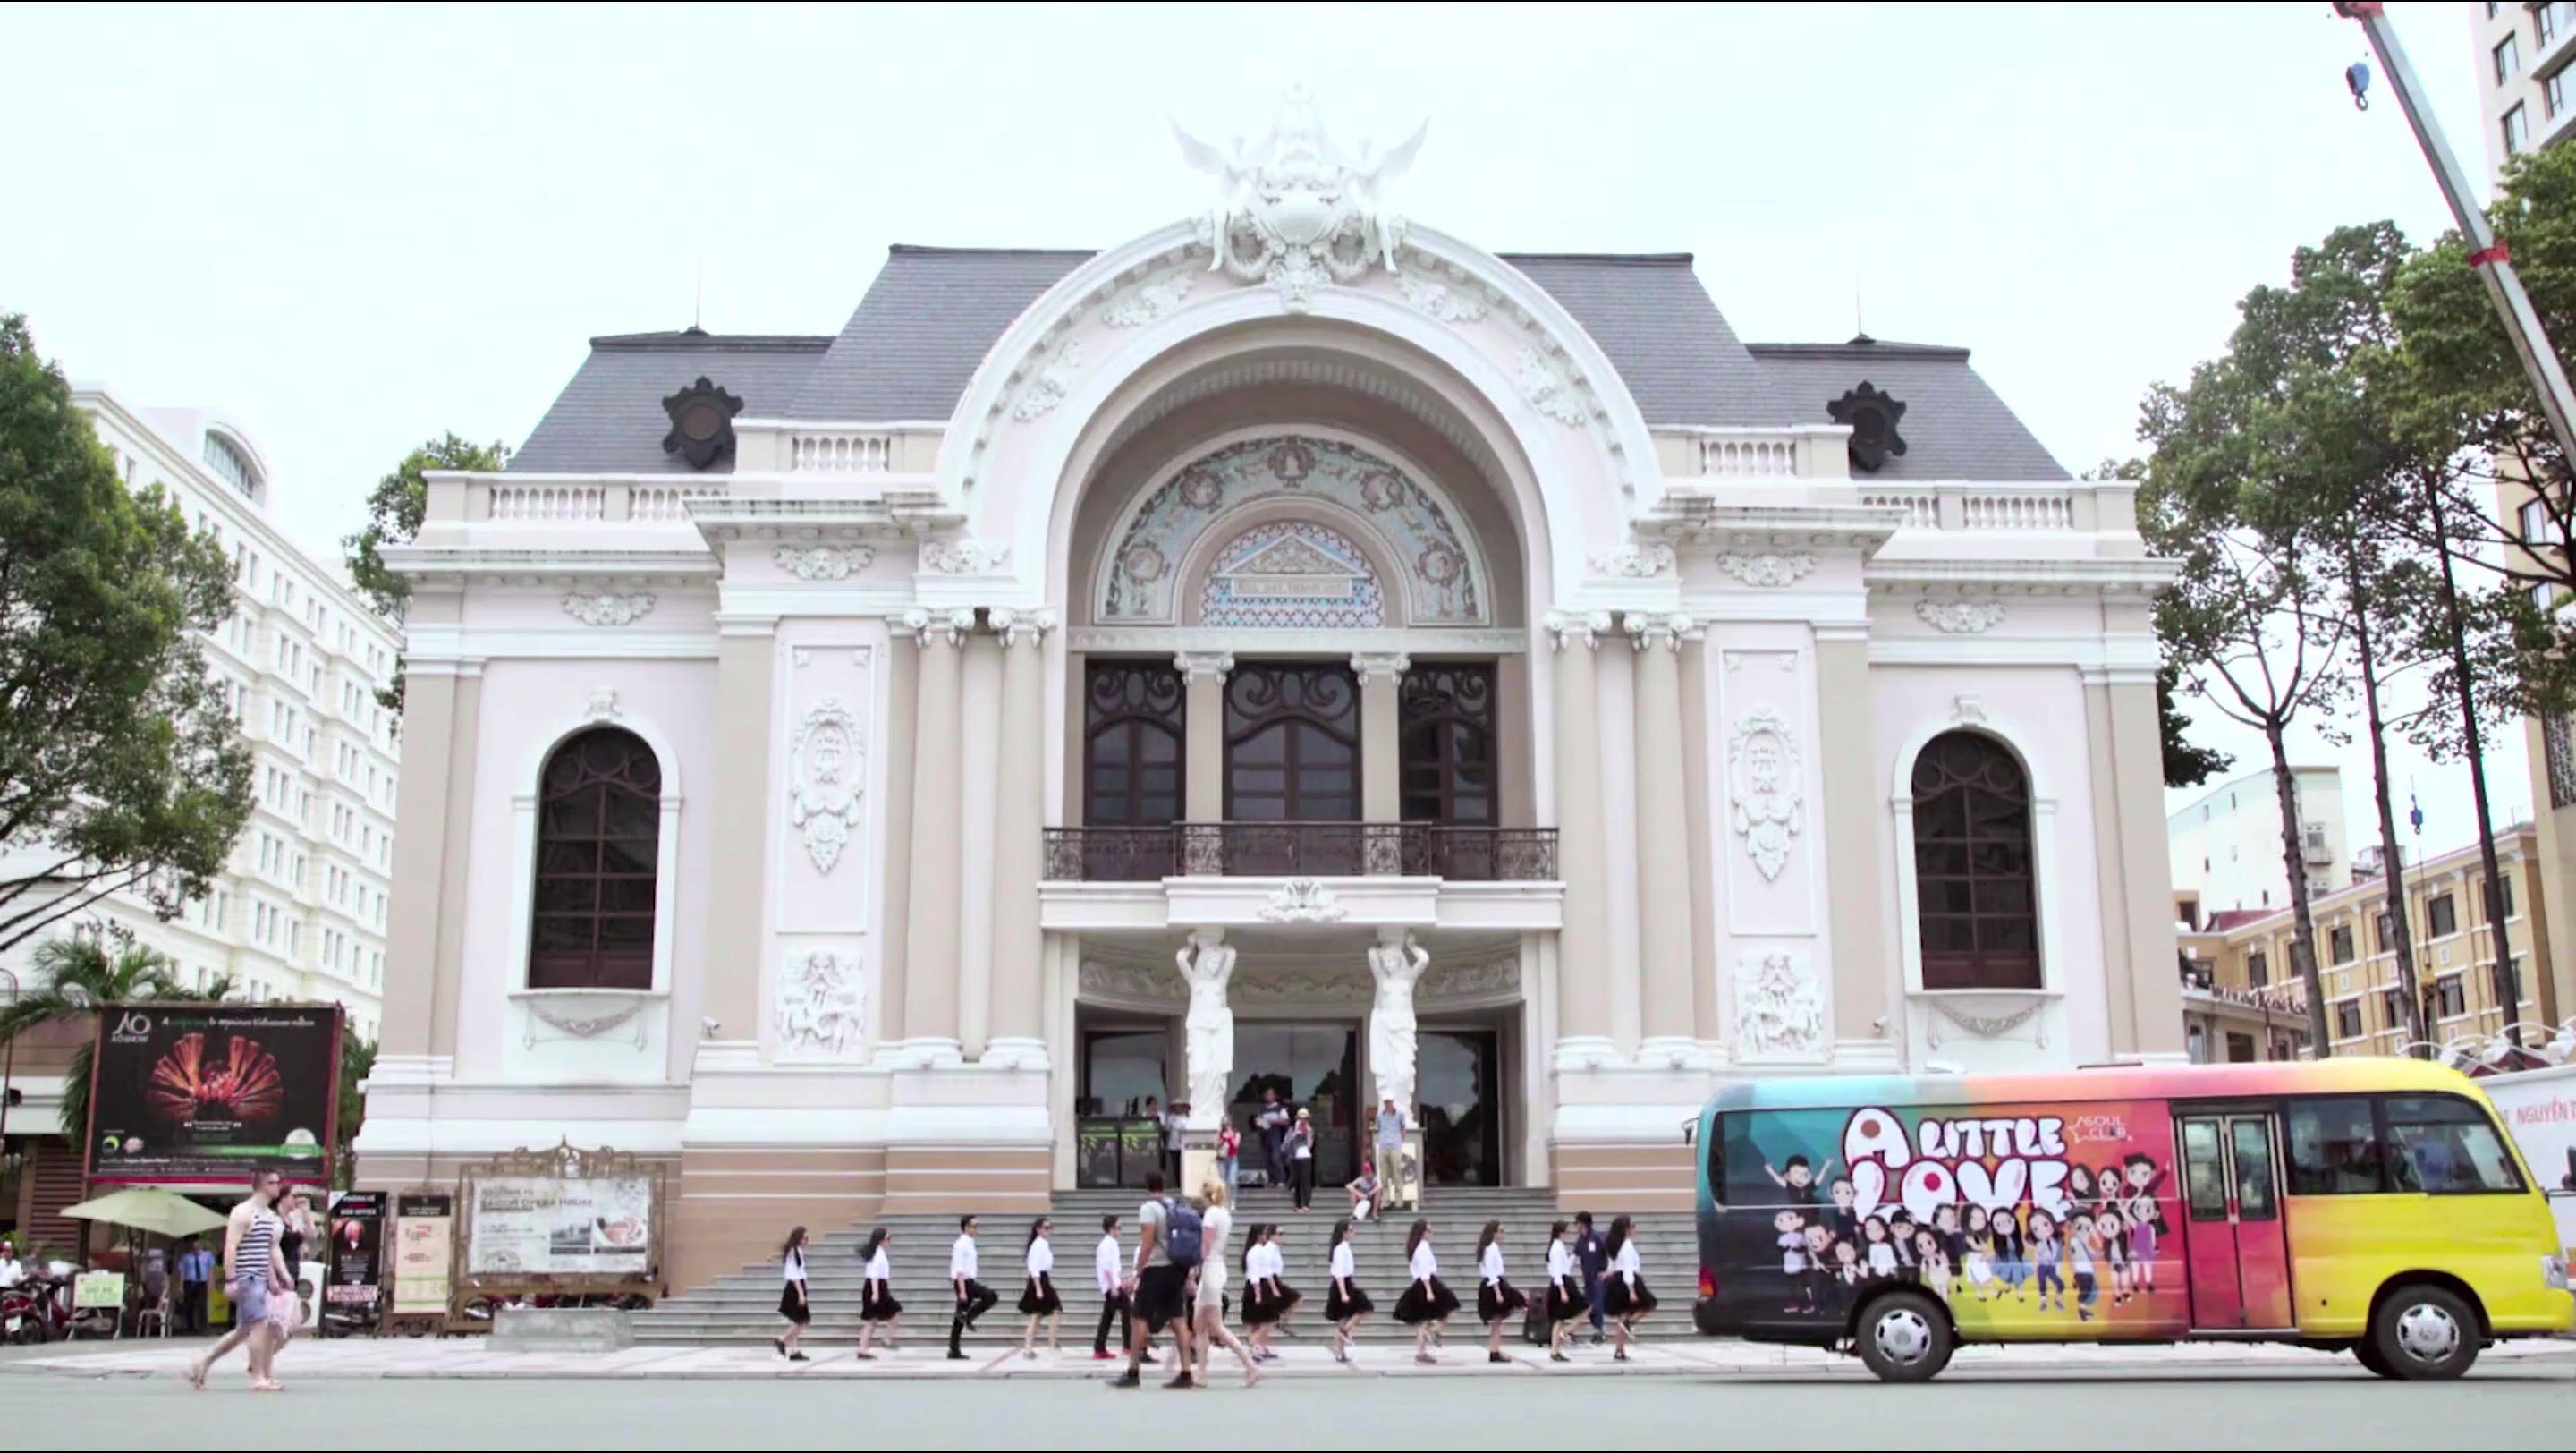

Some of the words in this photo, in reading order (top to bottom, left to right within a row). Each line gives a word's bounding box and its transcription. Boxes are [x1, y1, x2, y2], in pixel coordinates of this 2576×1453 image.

[1842, 1106, 1912, 1169] A
[1918, 1117, 2067, 1158] LITTLE
[1849, 1157, 2074, 1225] LOVE
